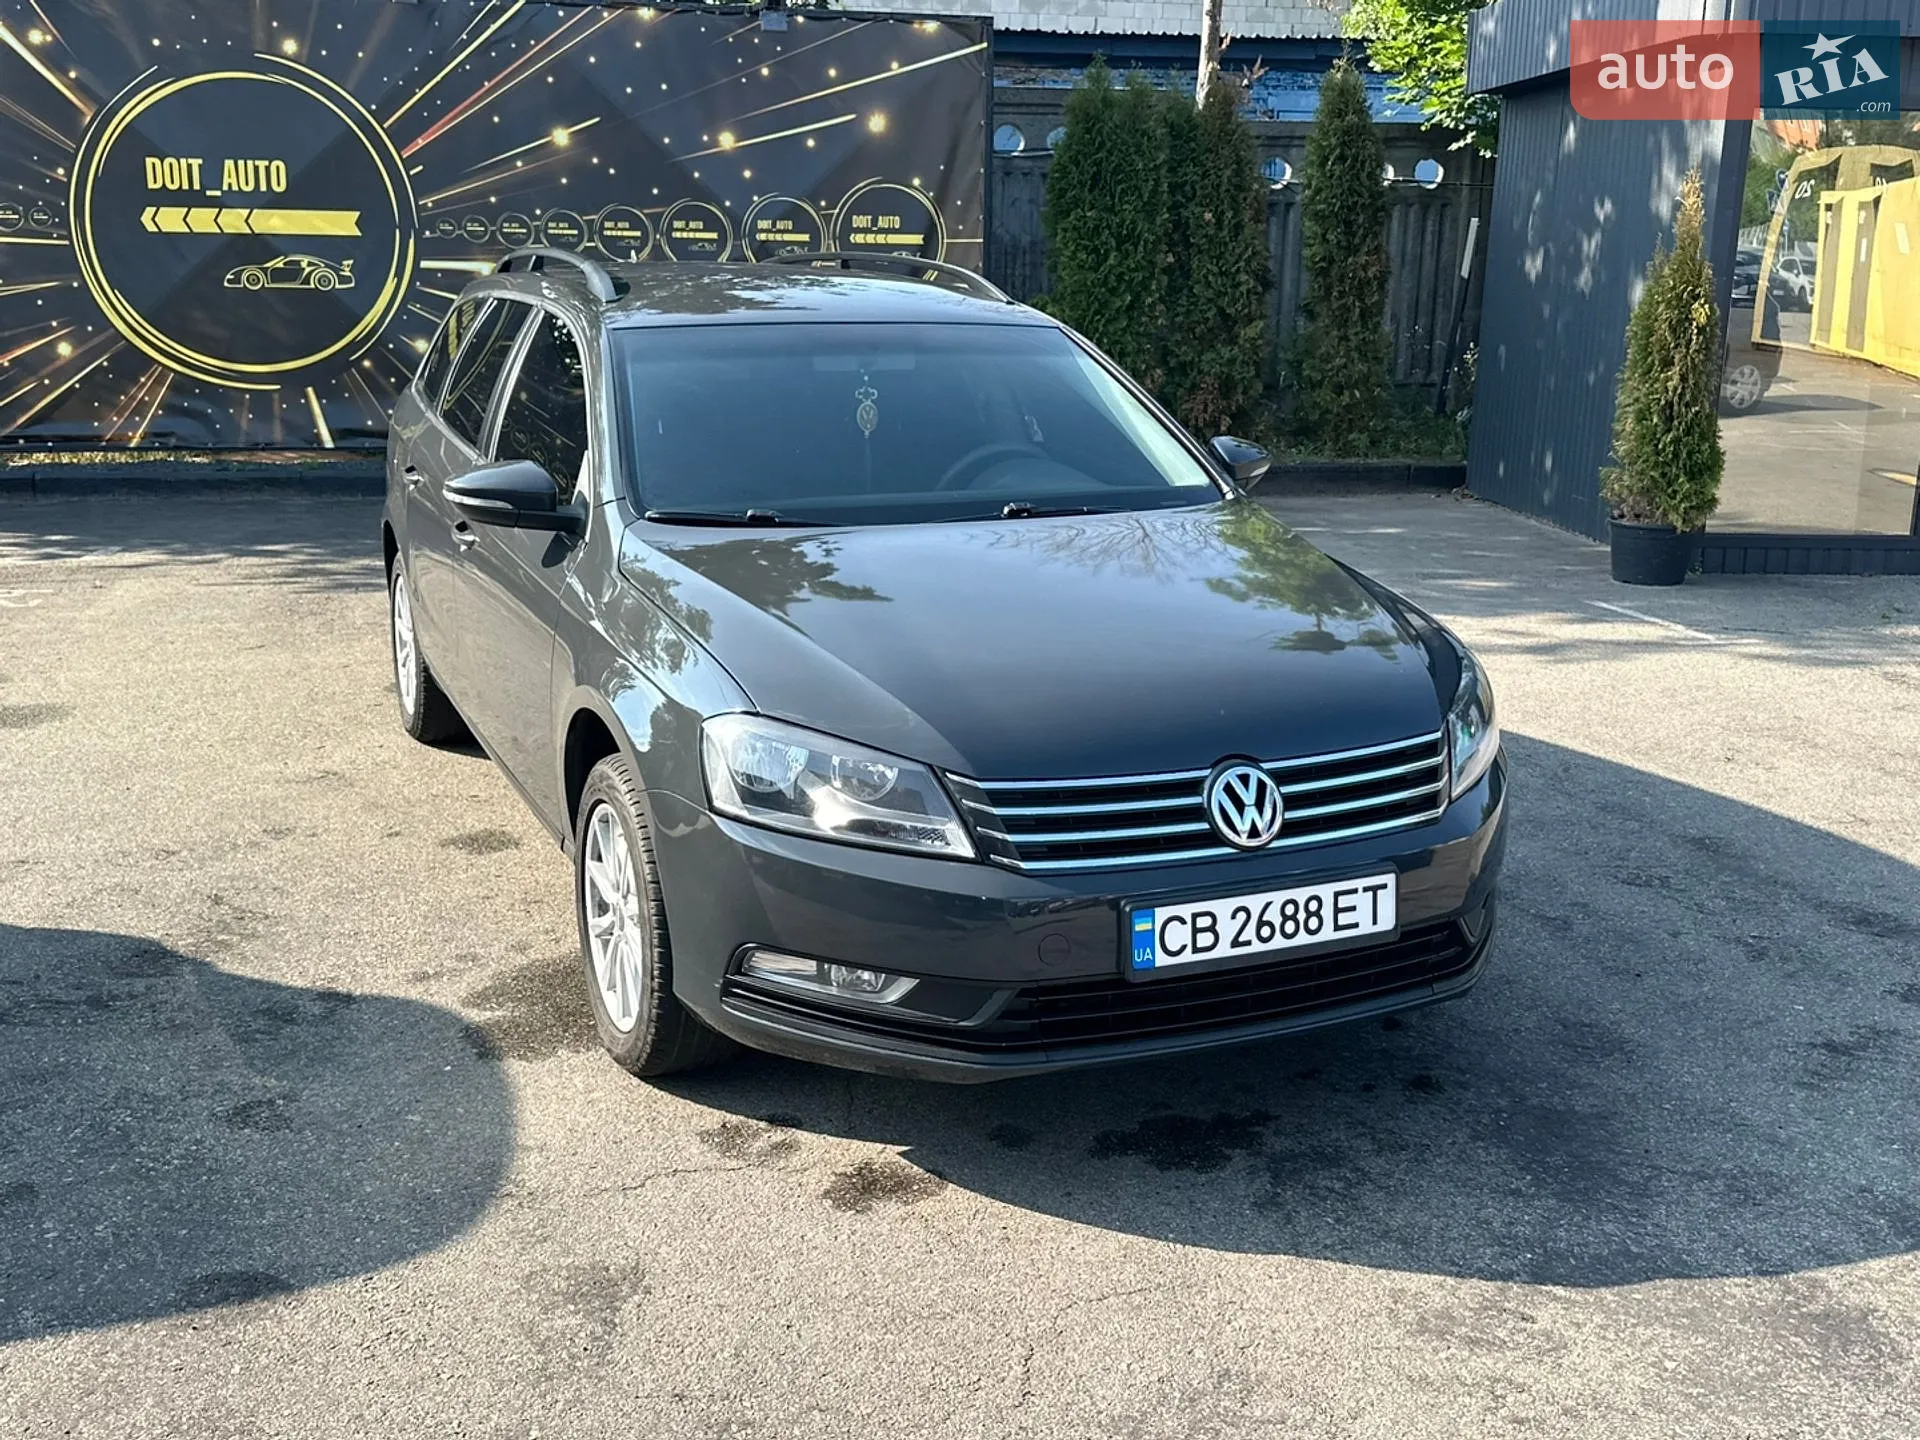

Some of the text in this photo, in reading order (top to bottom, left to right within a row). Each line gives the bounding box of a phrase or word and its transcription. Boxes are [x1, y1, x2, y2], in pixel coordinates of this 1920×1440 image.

[145, 156, 287, 196] DOIT_AUTO
[851, 214, 901, 231] DOIT_AUTO
[1158, 882, 1389, 958] CB 2688 ET
[1133, 946, 1153, 962] UA
